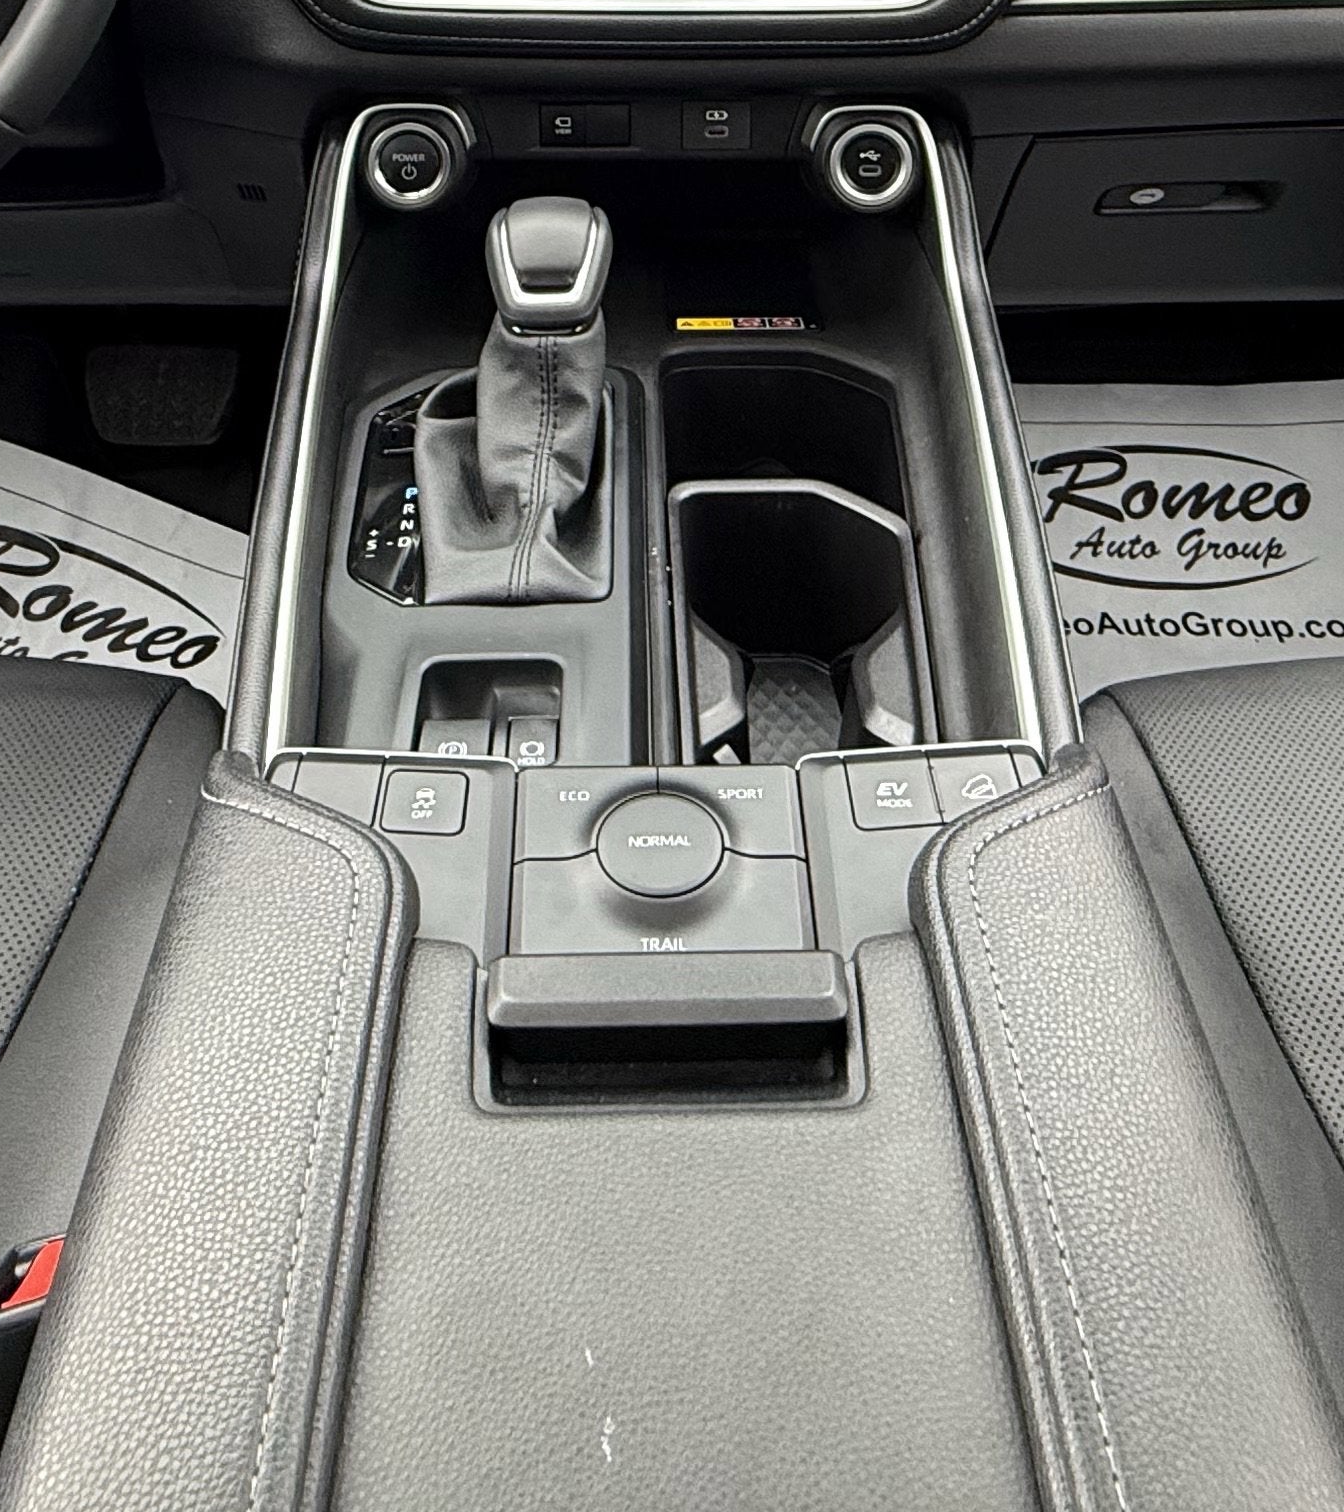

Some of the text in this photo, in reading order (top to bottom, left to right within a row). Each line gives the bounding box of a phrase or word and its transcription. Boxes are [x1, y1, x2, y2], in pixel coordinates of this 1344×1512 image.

[392, 153, 426, 163] POWER
[1037, 449, 1312, 524] Romeo
[405, 487, 418, 500] P
[402, 503, 416, 515] R
[400, 519, 415, 531] N
[366, 539, 378, 552] S
[1069, 526, 1288, 571] Auto Group
[517, 756, 546, 766] HOLD
[717, 788, 764, 800] SPORT
[876, 782, 909, 797] EV
[559, 790, 591, 802] ECO
[876, 798, 913, 808] MODE
[411, 809, 434, 820] OFF
[628, 834, 692, 848] NORMAL
[640, 937, 688, 952] TRAIL
